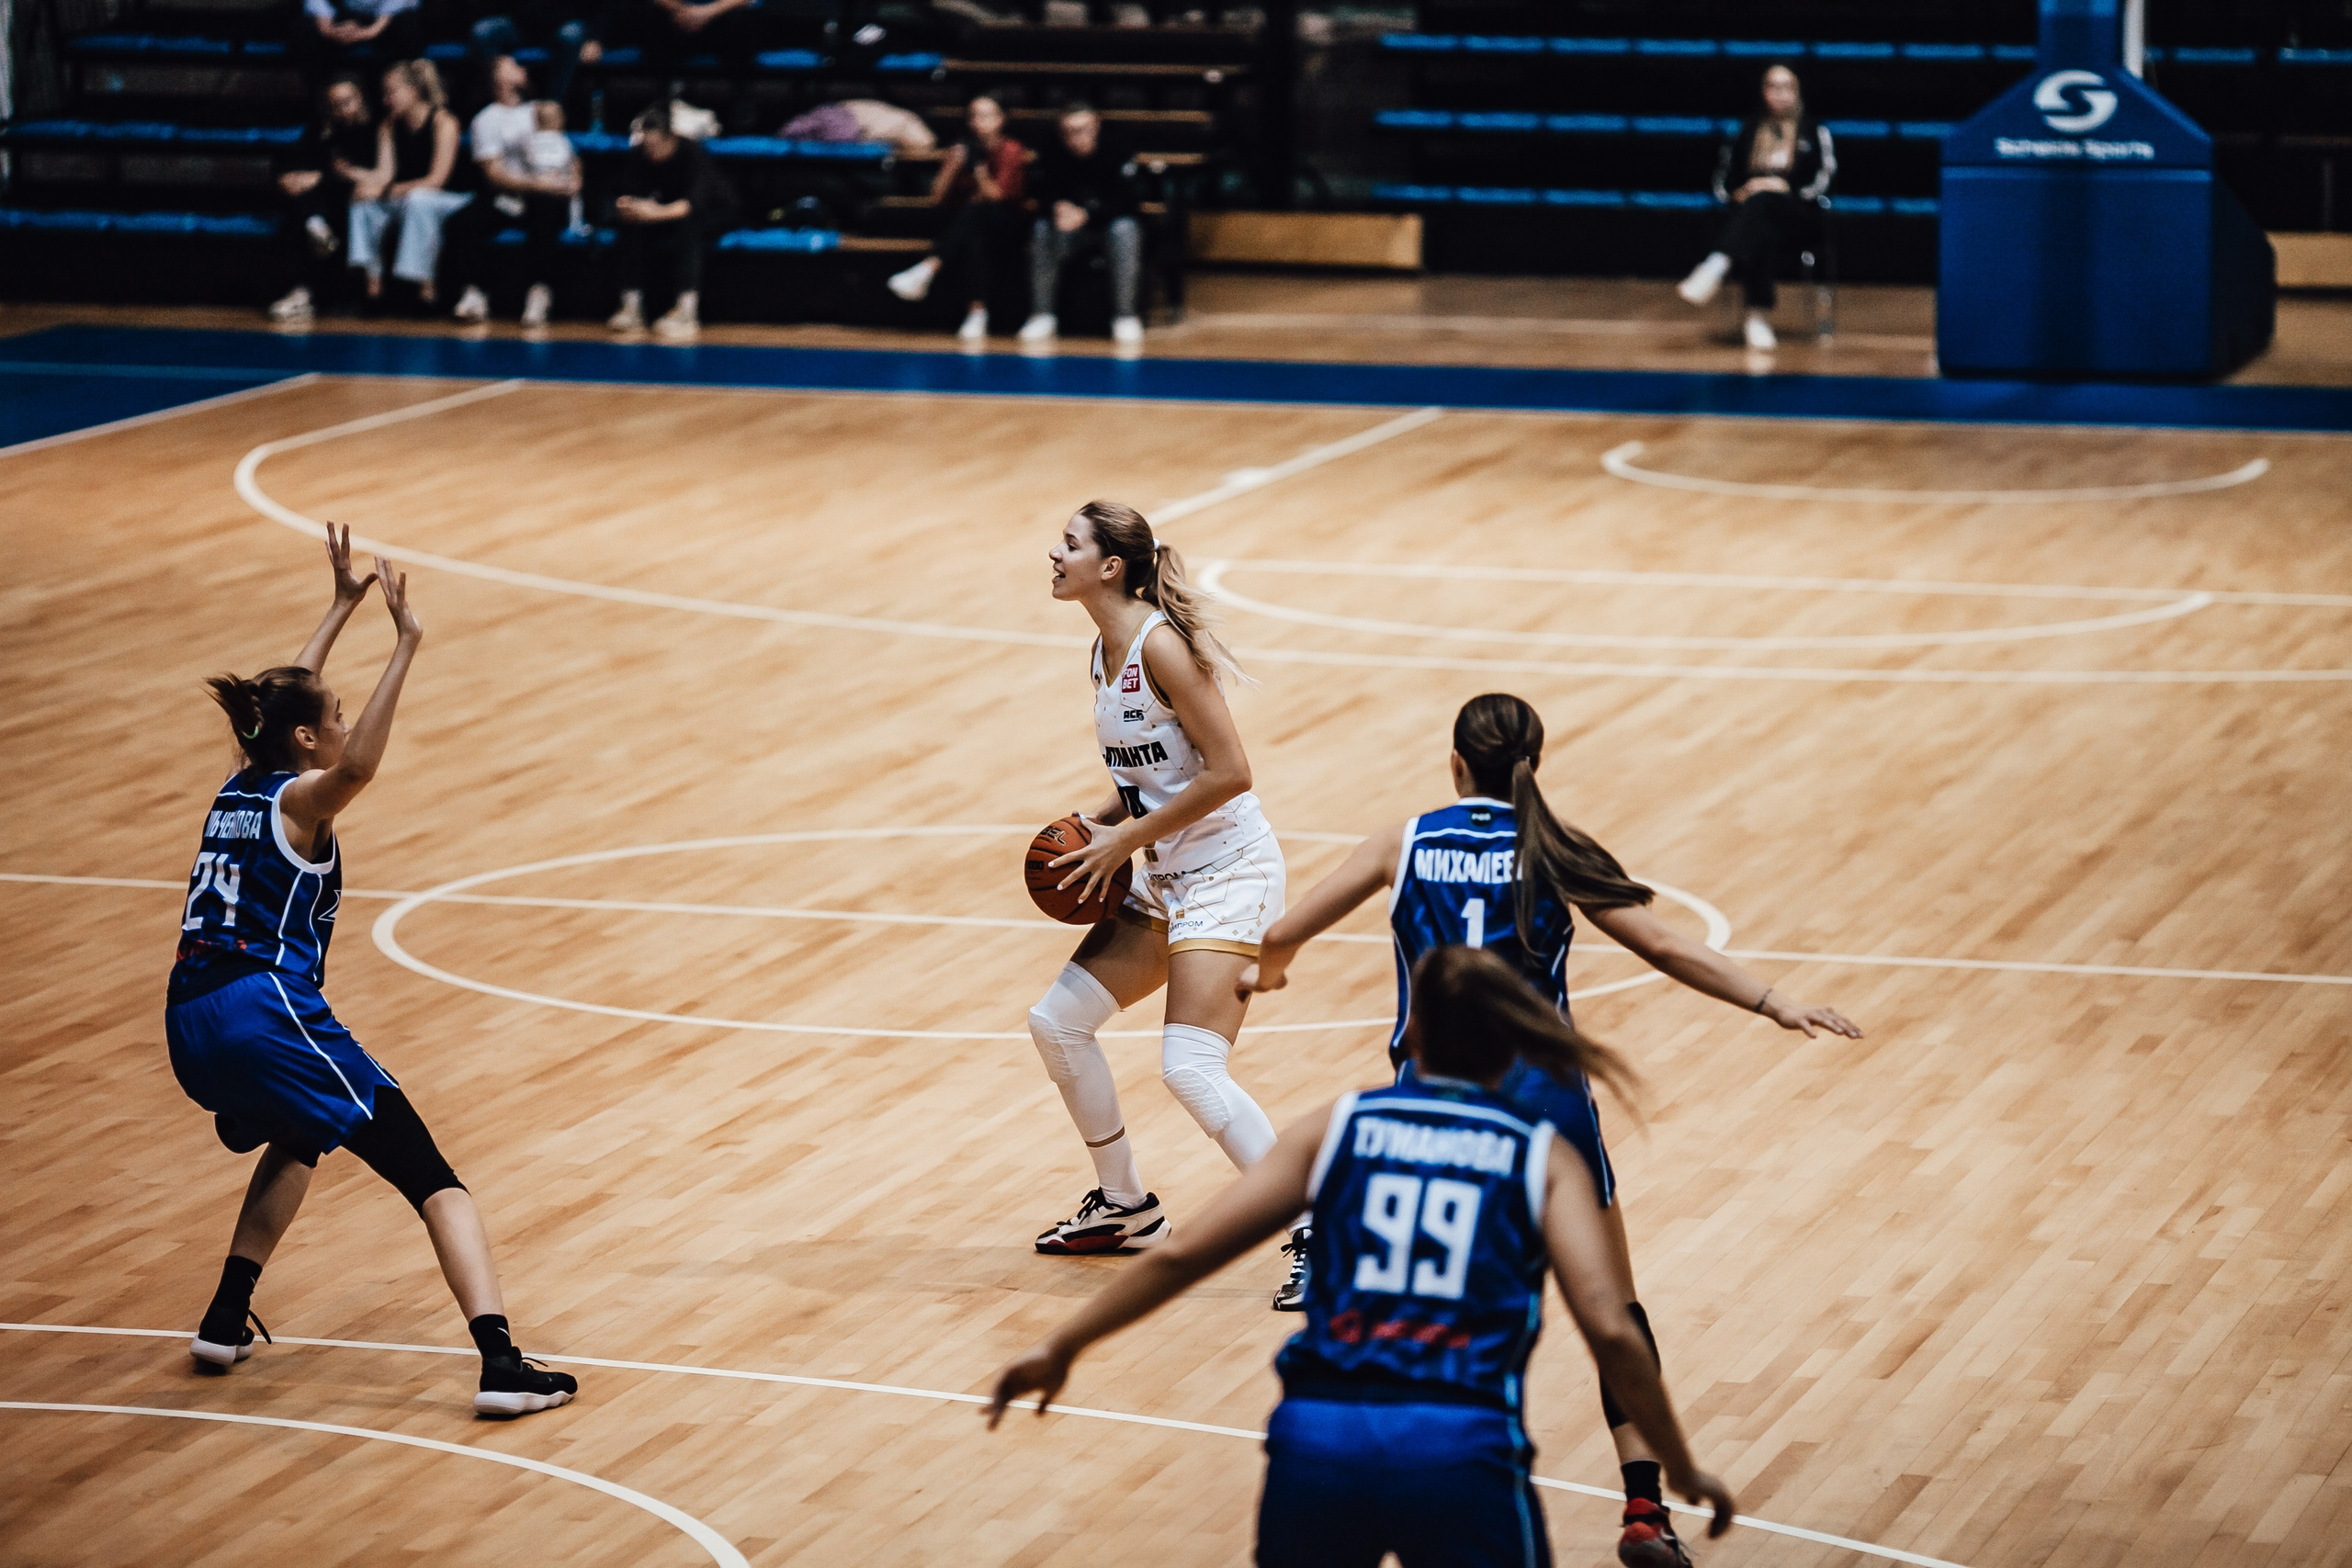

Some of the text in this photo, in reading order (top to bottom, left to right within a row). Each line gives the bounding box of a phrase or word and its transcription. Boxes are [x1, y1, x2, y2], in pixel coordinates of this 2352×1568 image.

[1123, 678, 1138, 689] BET
[182, 852, 241, 931] 24
[1461, 898, 1485, 950] 1
[1354, 1173, 1483, 1301] 99
